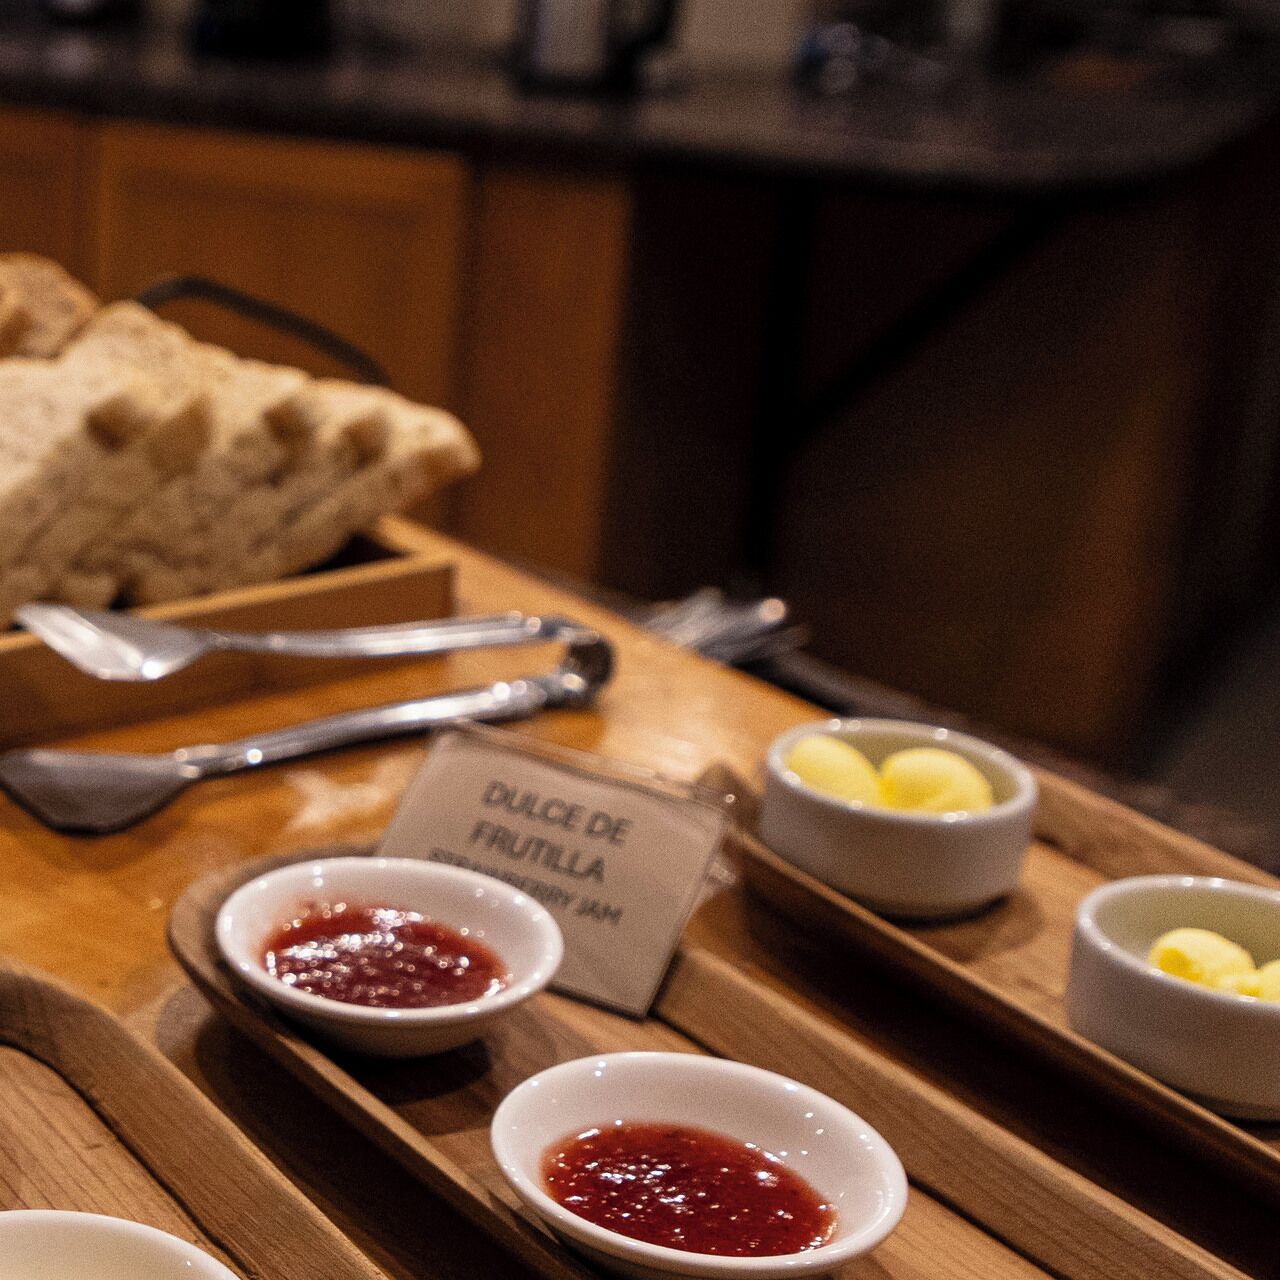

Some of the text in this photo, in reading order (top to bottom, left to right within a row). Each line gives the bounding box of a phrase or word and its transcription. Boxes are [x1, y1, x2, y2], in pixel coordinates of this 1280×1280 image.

[481, 781, 632, 846] DULCE DE
[470, 819, 605, 883] FRUTILLA
